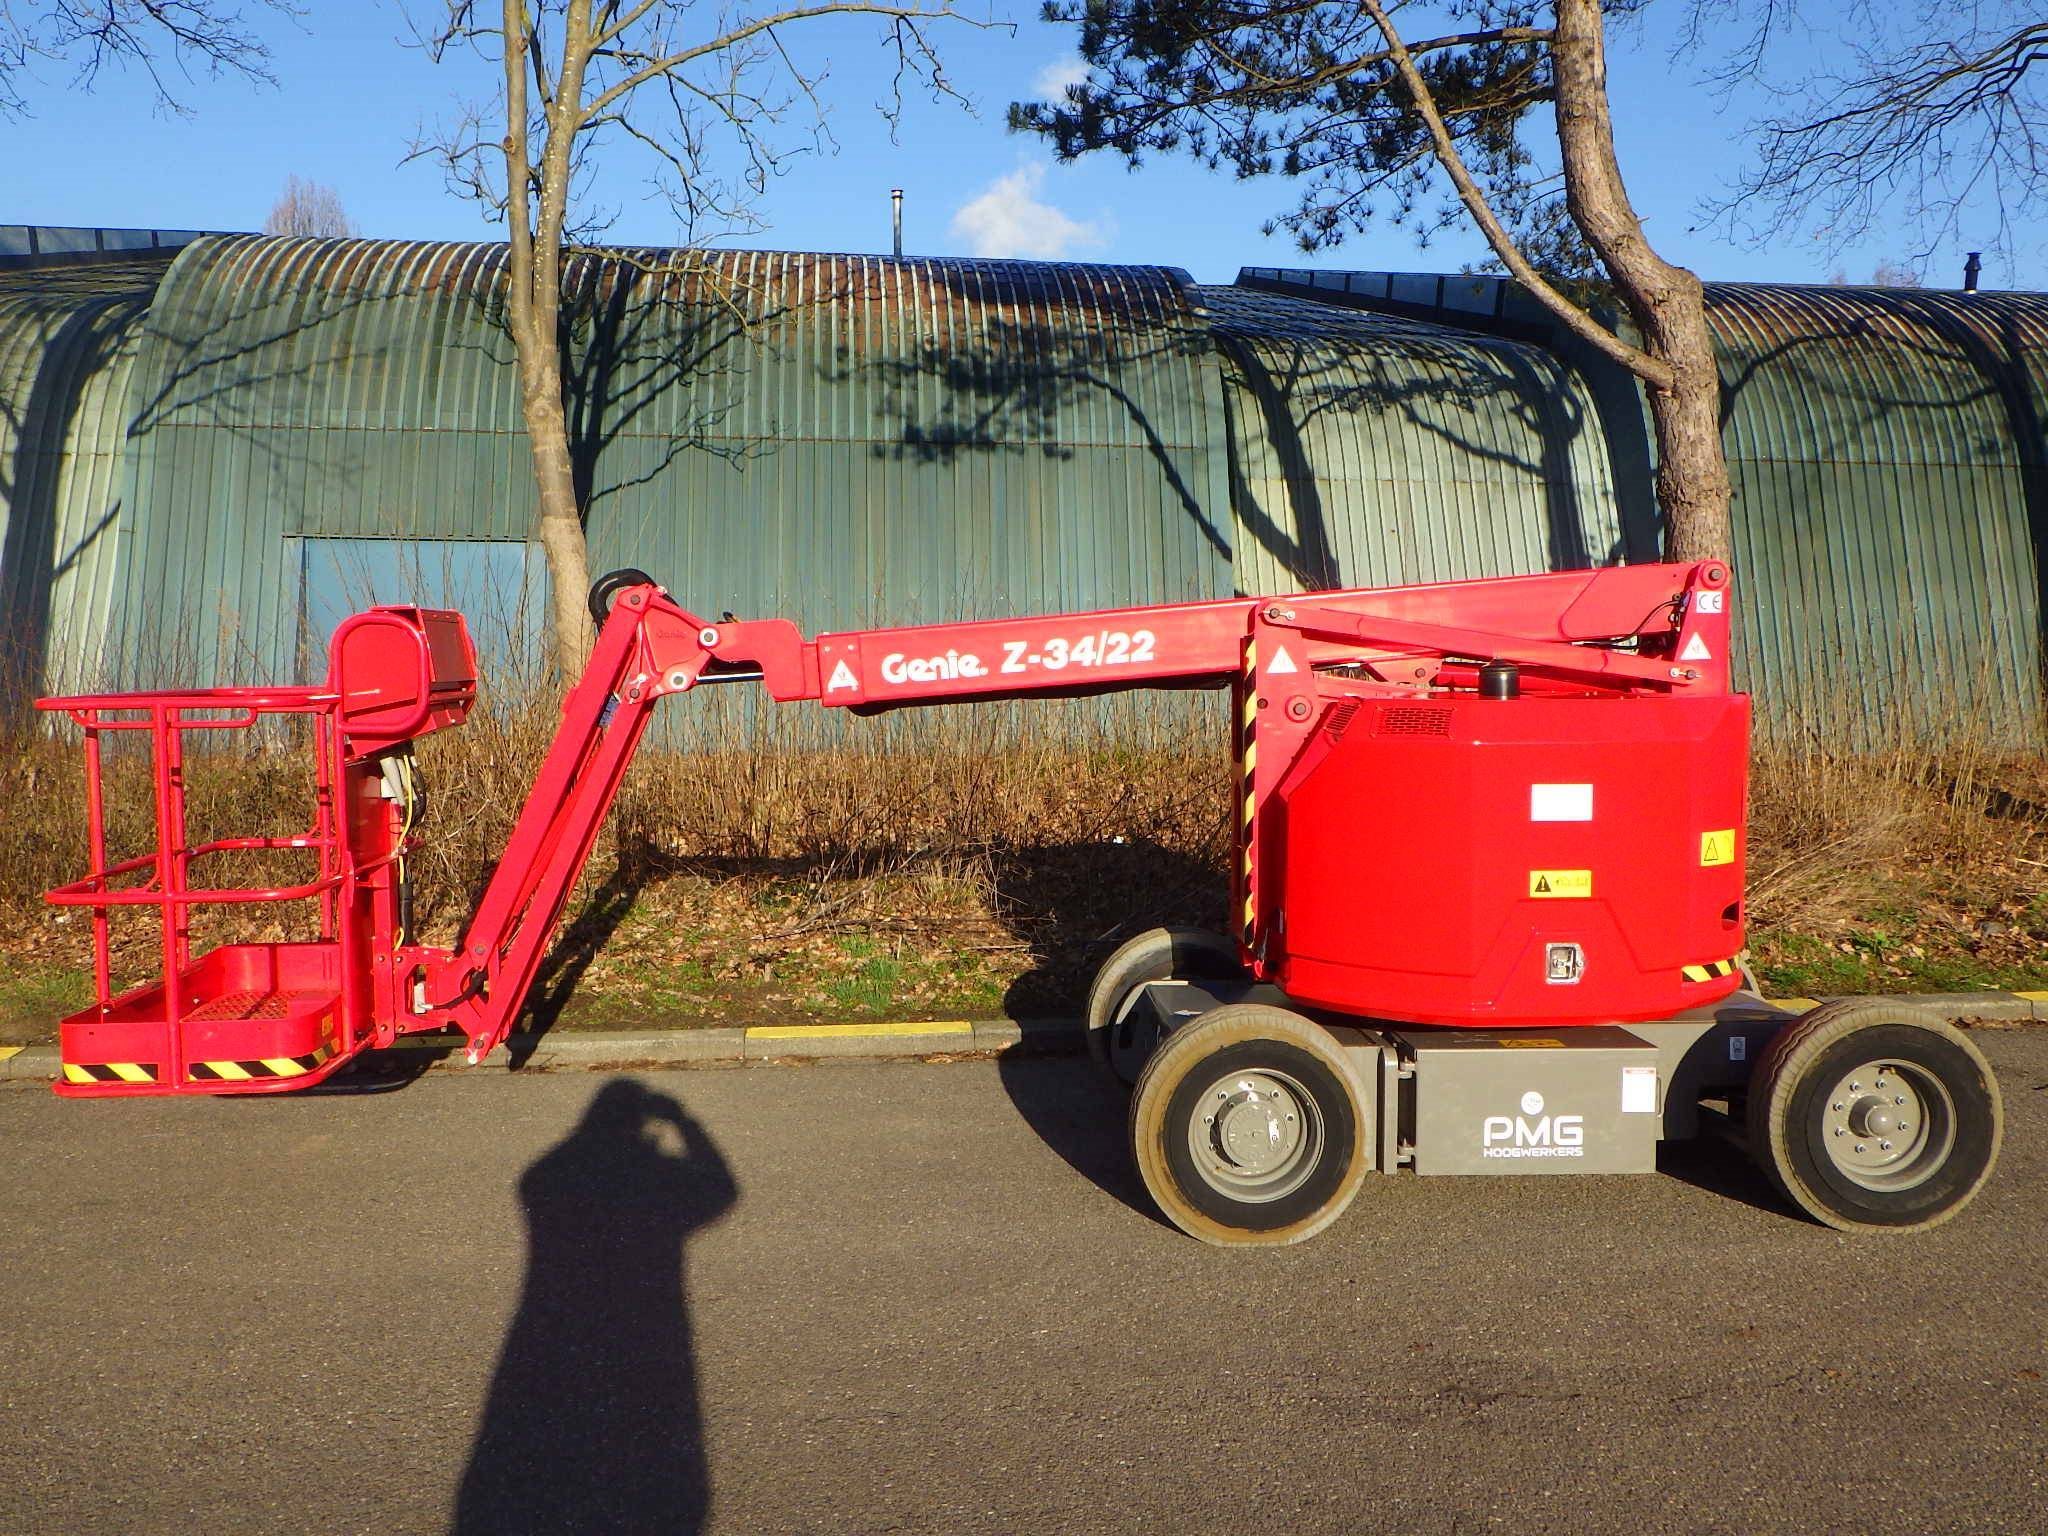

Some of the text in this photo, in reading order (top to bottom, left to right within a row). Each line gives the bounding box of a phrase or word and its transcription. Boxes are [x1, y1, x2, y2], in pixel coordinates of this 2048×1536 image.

[1001, 630, 1156, 673] Z-34/22
[1483, 1115, 1584, 1147] PMG
[1483, 1146, 1584, 1158] HOOGWERKERS
